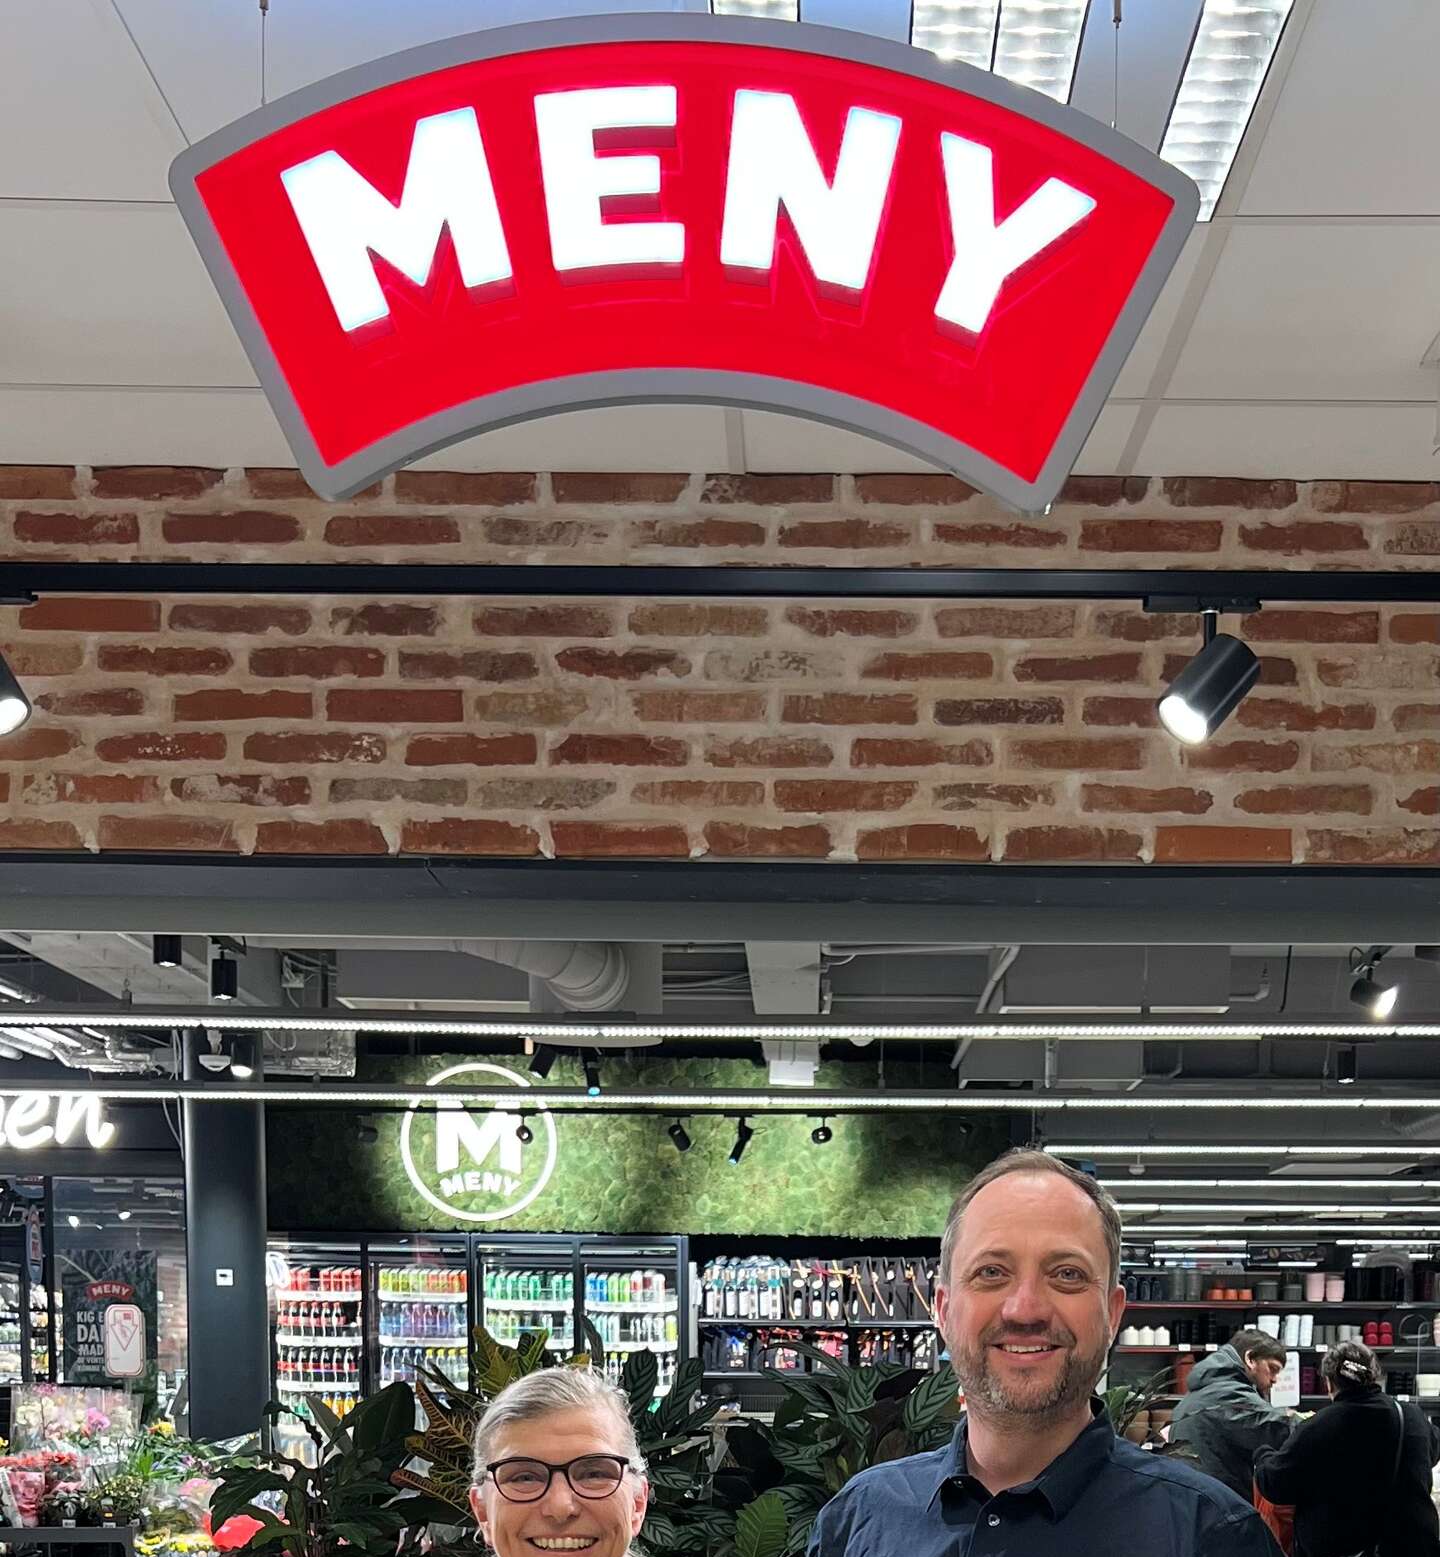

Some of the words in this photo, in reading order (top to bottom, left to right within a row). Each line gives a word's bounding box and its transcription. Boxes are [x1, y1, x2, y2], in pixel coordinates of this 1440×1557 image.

[280, 85, 1097, 335] MENY
[0, 1092, 115, 1149] en
[436, 1099, 522, 1174] M
[439, 1171, 521, 1197] MENY
[91, 1284, 131, 1296] MENY
[76, 1311, 95, 1323] KIG
